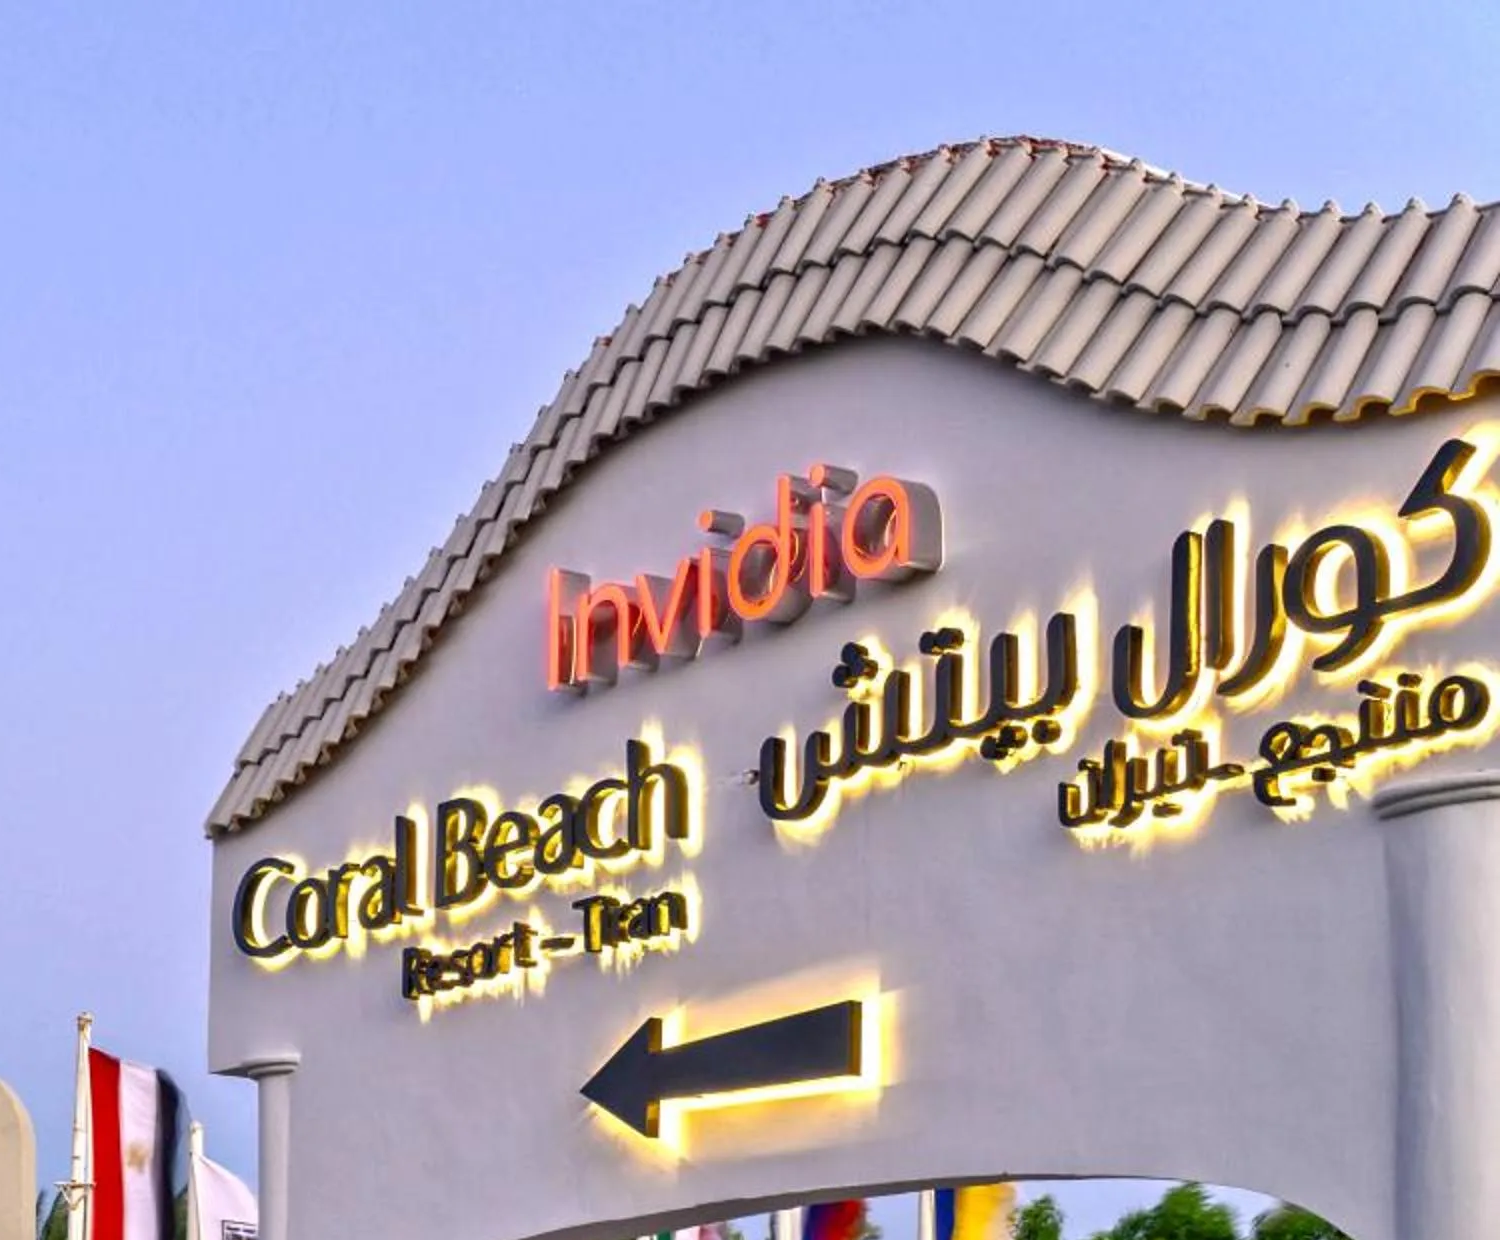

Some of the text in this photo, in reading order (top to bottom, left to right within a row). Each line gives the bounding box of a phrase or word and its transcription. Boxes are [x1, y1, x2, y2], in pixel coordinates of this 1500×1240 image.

[546, 464, 943, 697] Invidia
[759, 439, 1491, 820] كورال بيتش
[232, 739, 689, 958] Coral Beach
[1253, 673, 1491, 807] منتجع
[402, 921, 538, 1001] Resort
